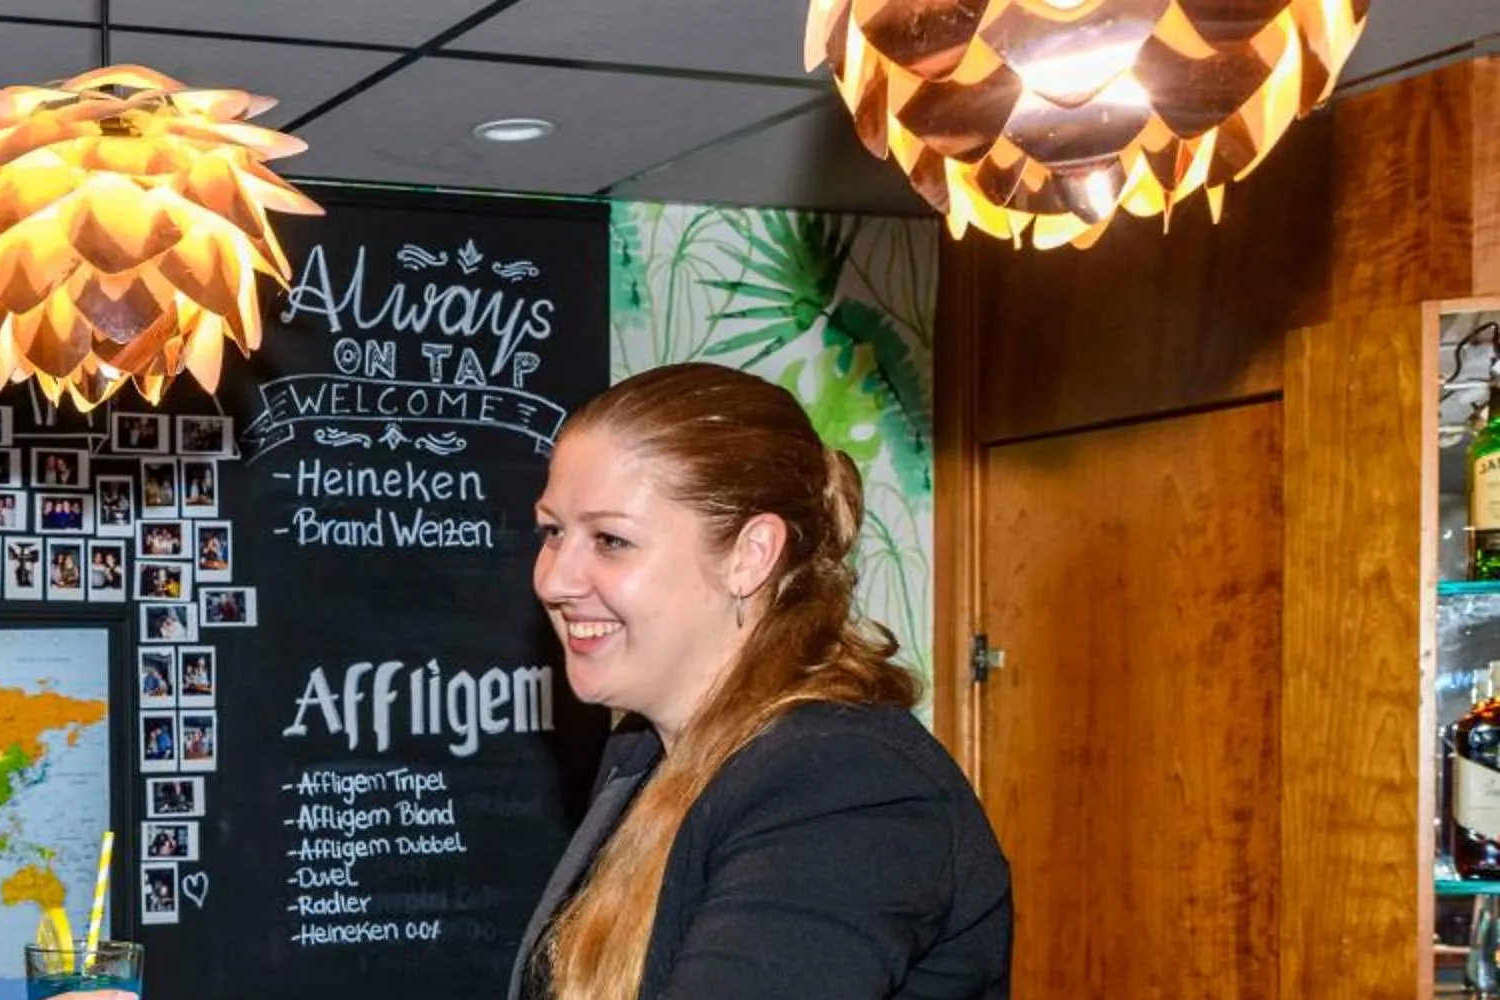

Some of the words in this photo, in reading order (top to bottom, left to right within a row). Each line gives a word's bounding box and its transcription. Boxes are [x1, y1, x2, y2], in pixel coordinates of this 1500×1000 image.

[333, 337, 397, 379] ON
[421, 343, 542, 388] TAP
[289, 383, 504, 423] WELCOME
[388, 507, 494, 548] Weizen
[282, 658, 555, 757] Affligem
[394, 798, 455, 826] Blond
